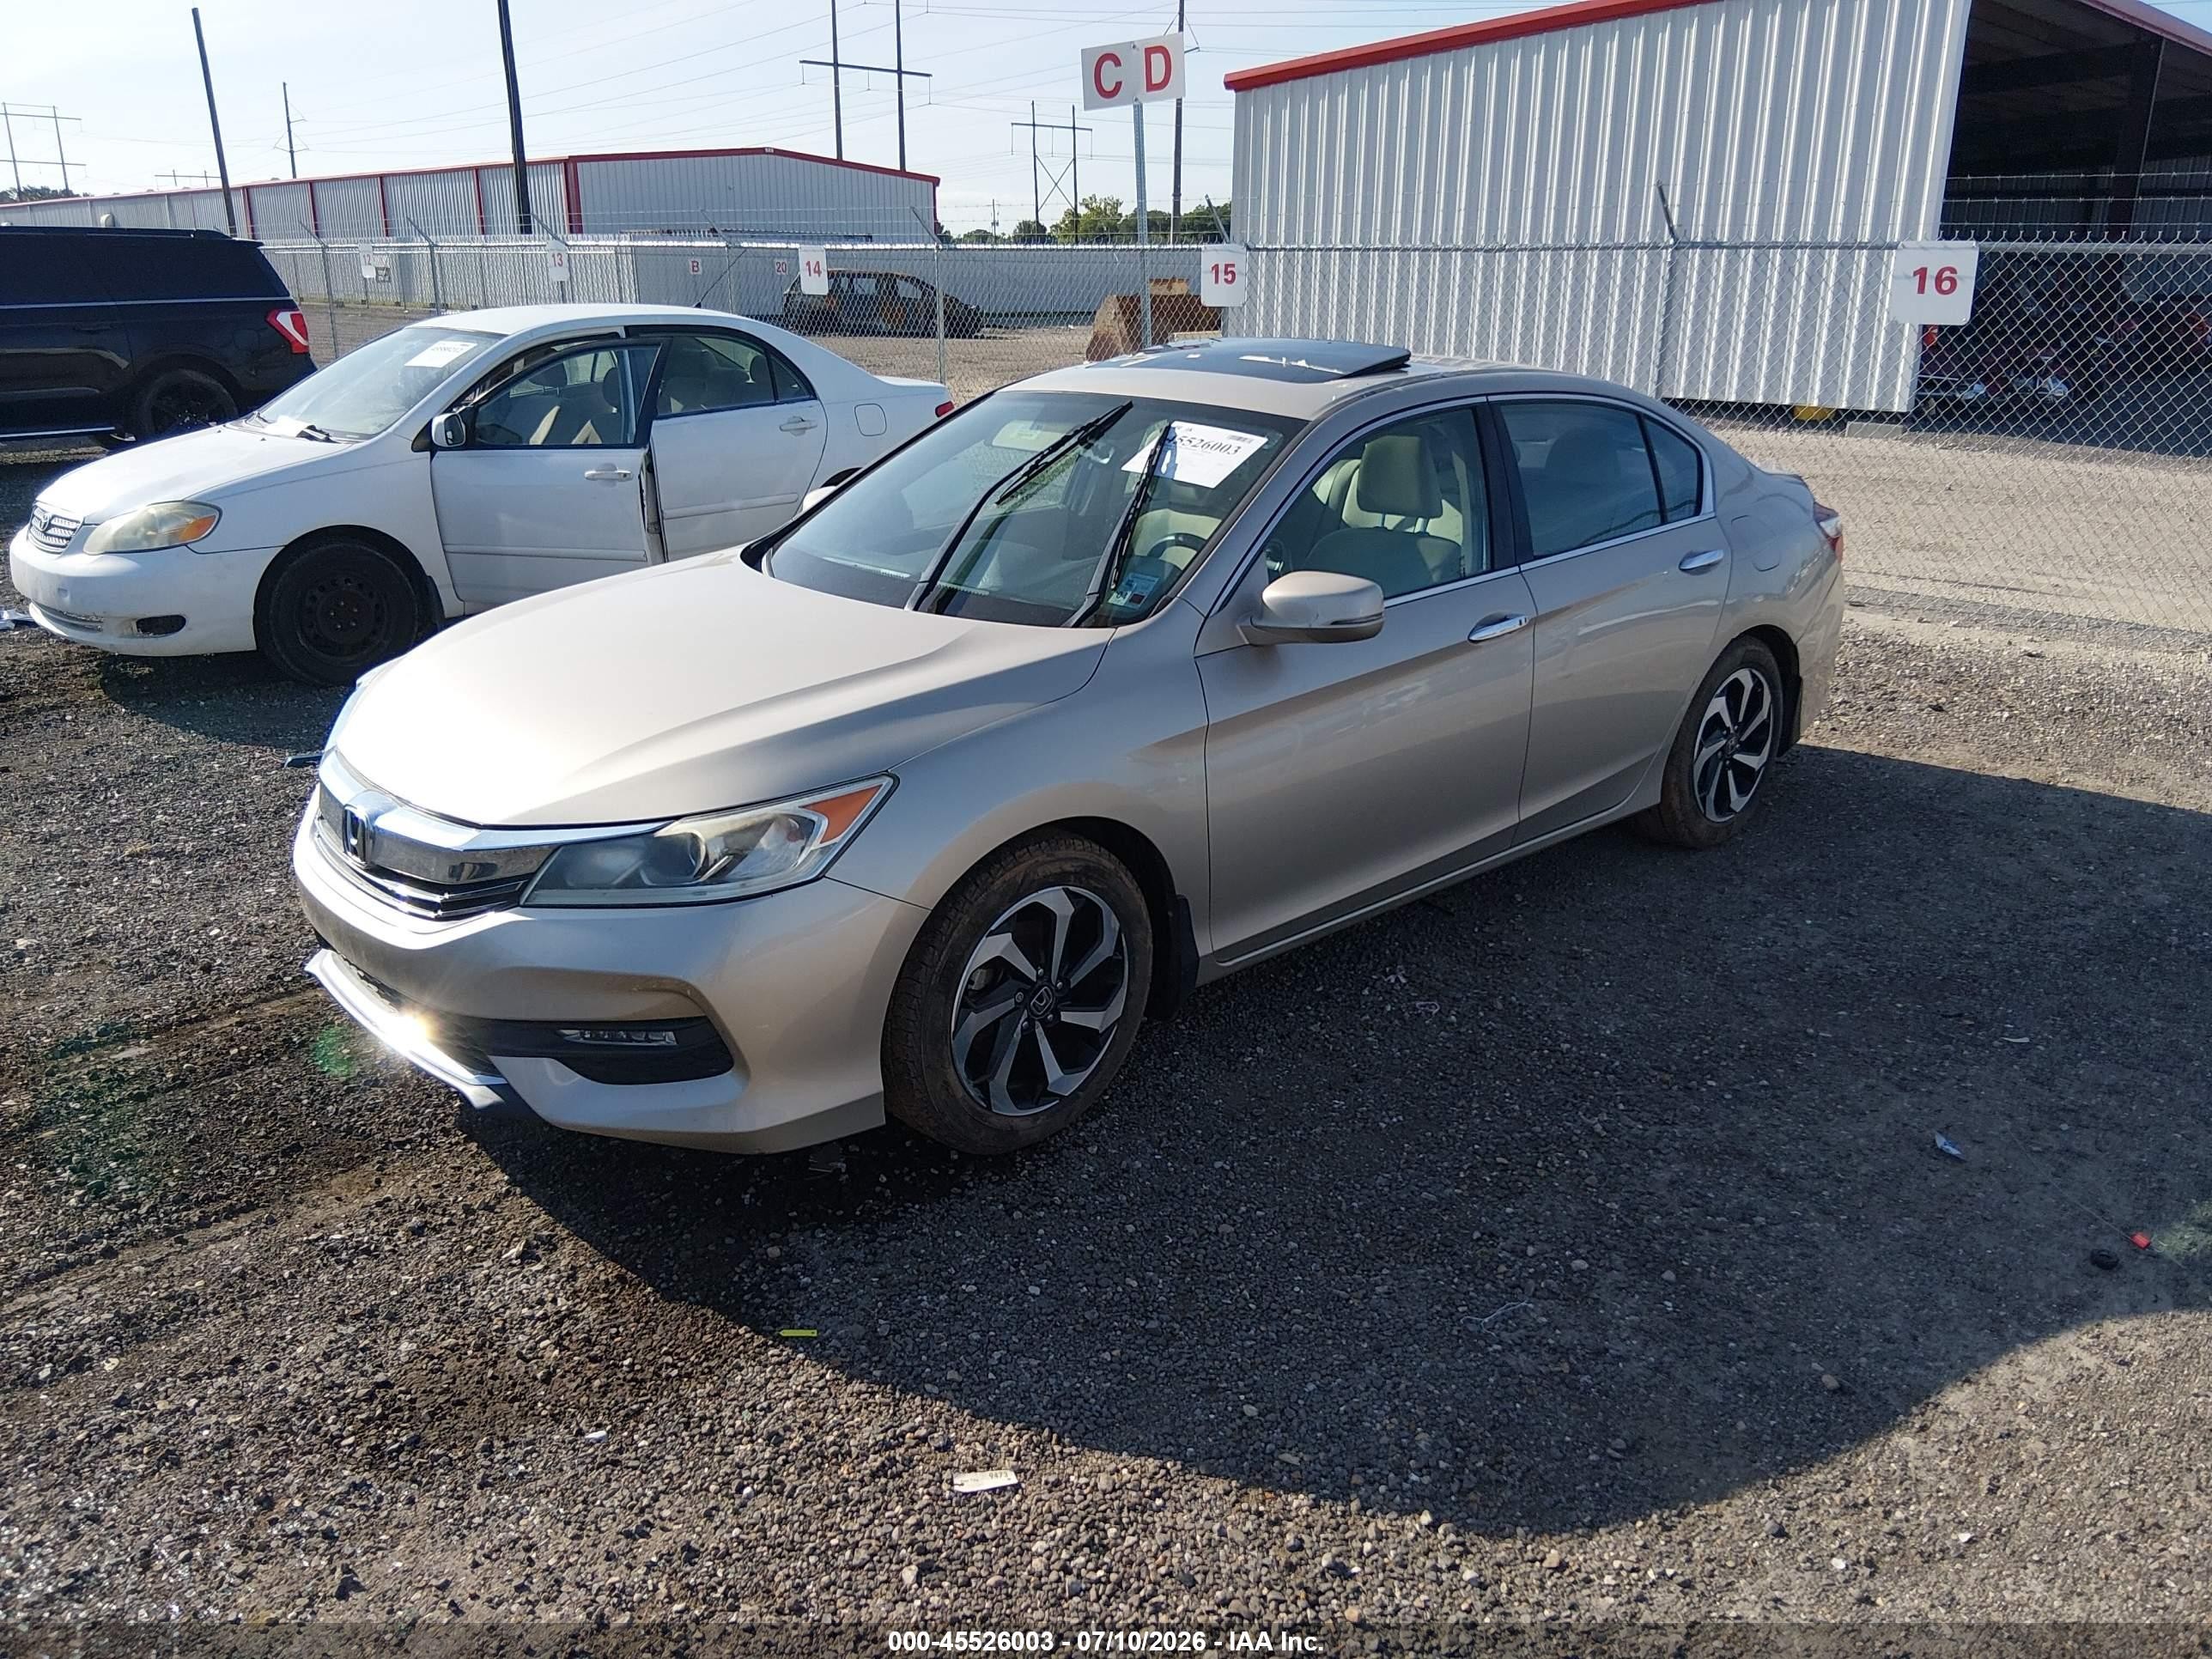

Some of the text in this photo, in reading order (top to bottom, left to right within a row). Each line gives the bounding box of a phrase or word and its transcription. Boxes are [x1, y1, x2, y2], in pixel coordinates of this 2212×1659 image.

[1094, 52, 1122, 100] C
[1144, 46, 1172, 93] D
[362, 253, 372, 265] 12
[551, 252, 564, 267] 13
[691, 260, 700, 273] B
[775, 261, 787, 273] 20
[805, 260, 822, 277] 14
[1211, 263, 1237, 285] 15
[1912, 266, 1958, 295] 16
